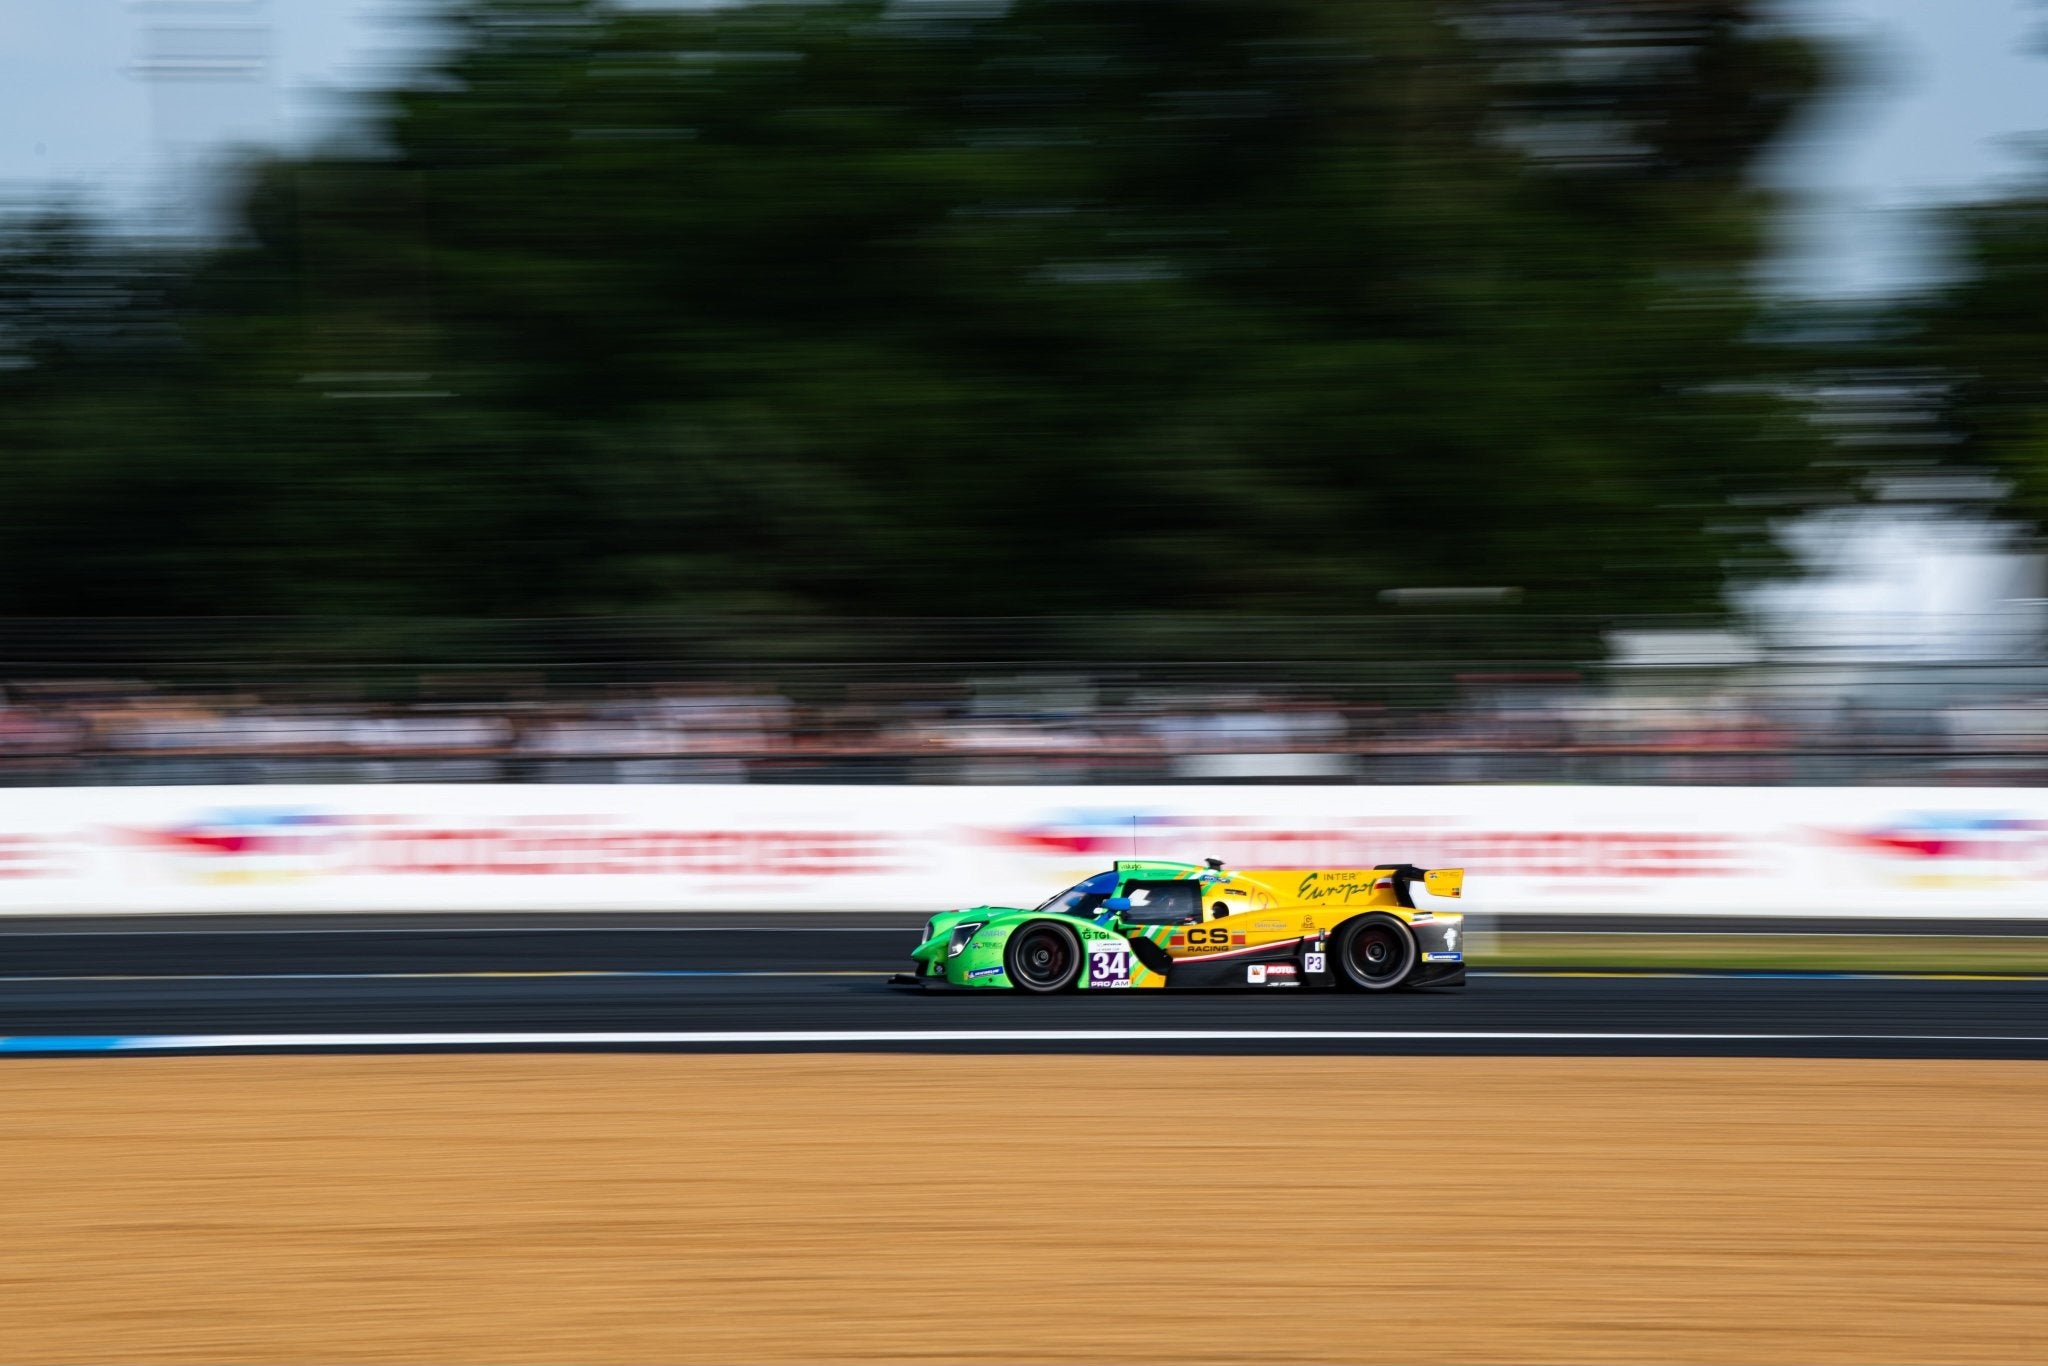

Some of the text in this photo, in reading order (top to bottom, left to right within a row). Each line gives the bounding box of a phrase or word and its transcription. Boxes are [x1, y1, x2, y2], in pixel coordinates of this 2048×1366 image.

[1323, 872, 1357, 881] INTER
[1093, 931, 1110, 939] TGI
[1187, 928, 1229, 944] CS
[1092, 952, 1127, 979] 34
[1307, 956, 1322, 970] P3
